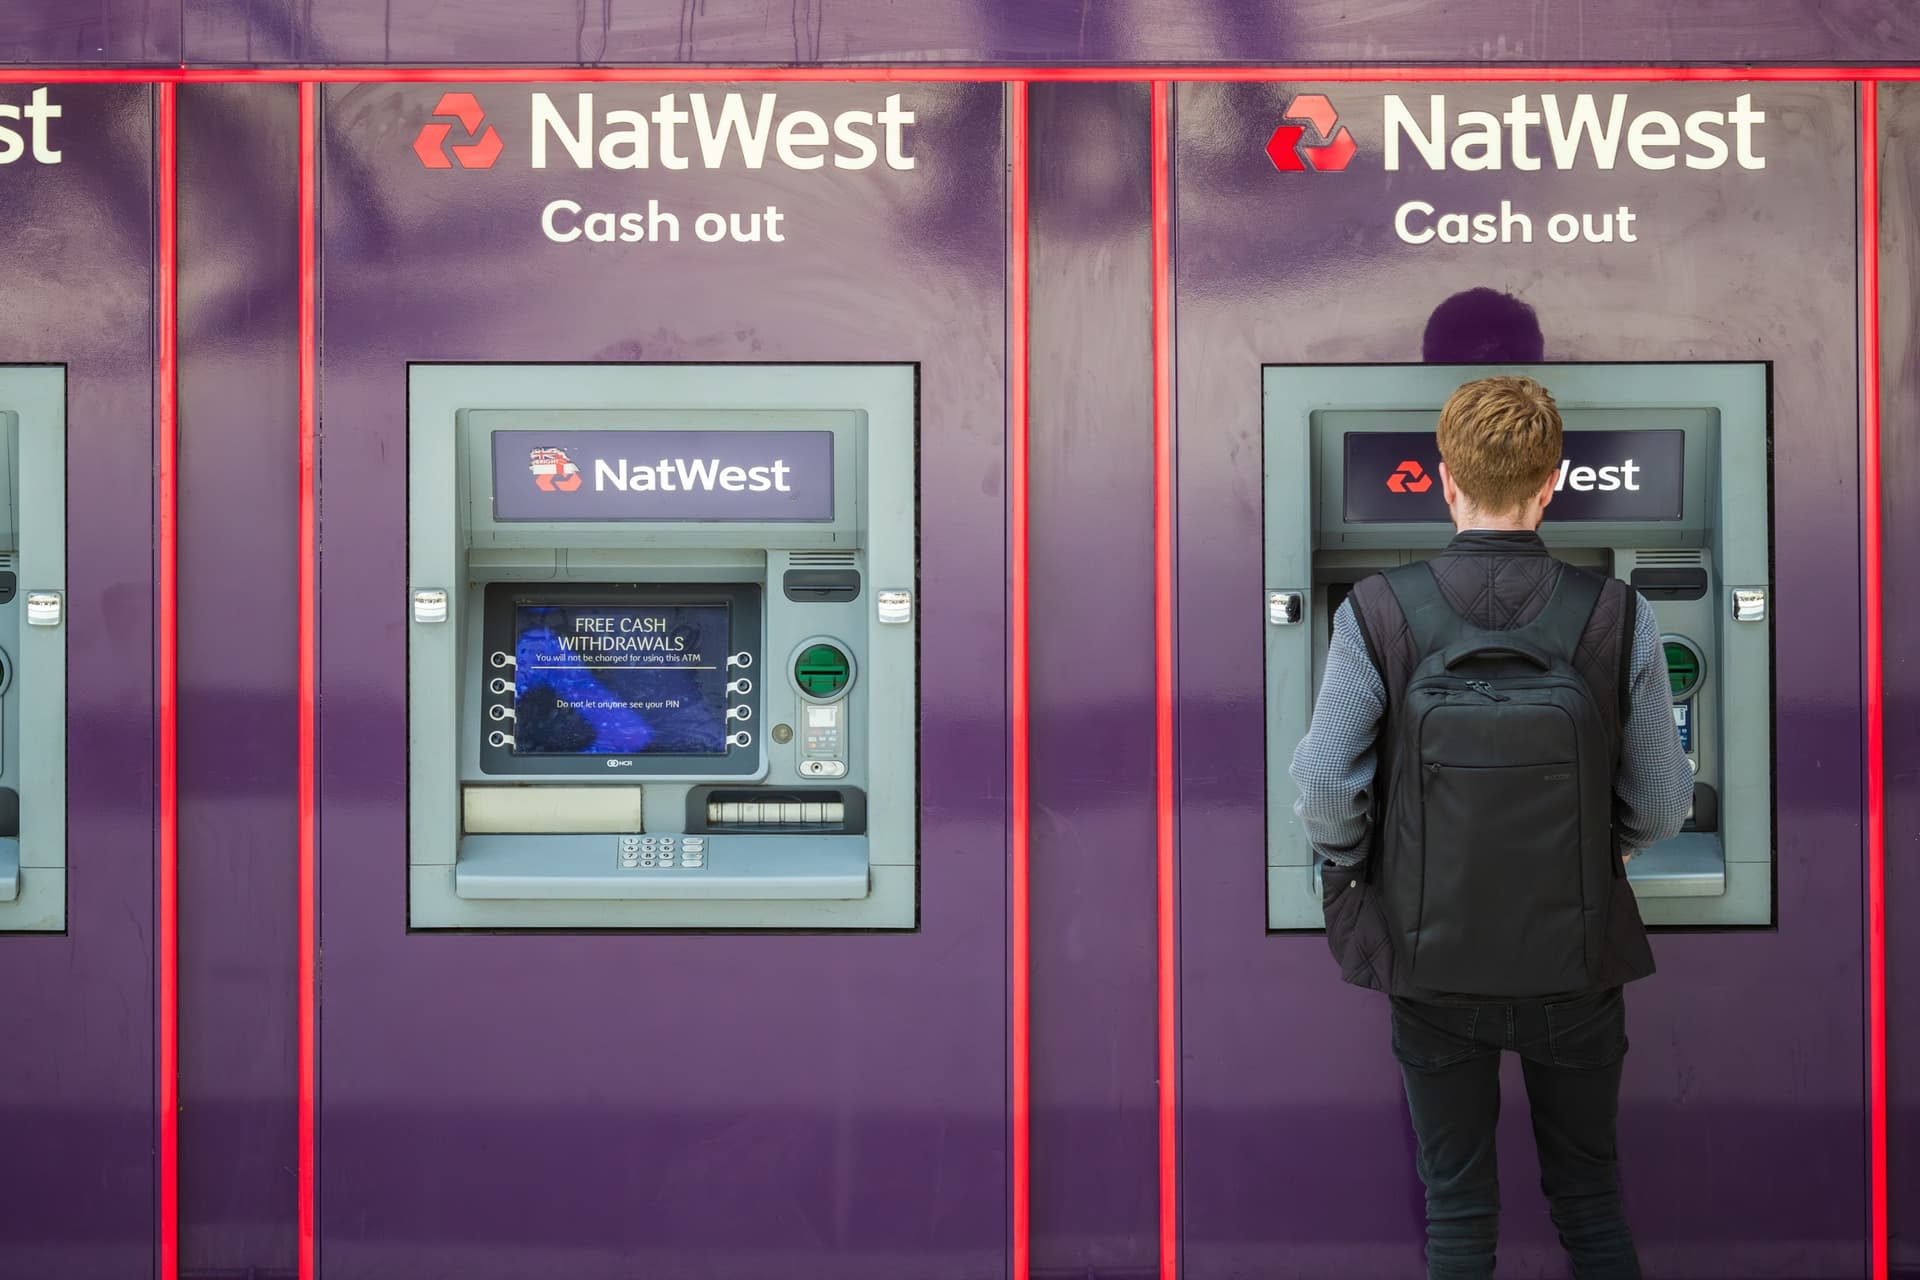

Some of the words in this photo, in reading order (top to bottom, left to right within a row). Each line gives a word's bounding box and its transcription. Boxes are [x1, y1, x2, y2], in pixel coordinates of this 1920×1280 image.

[530, 92, 916, 170] NatWest
[1383, 93, 1767, 171] NatWest
[541, 199, 681, 243] Cash
[694, 205, 786, 243] out
[1394, 200, 1533, 245] Cash
[1547, 205, 1638, 244] out
[594, 457, 791, 492] NatWest
[1555, 458, 1641, 491] est
[575, 617, 615, 633] FREE
[620, 617, 666, 633] CASH
[535, 653, 551, 662] You
[553, 653, 566, 662] will
[567, 654, 581, 662] not
[583, 653, 593, 662] be
[595, 653, 627, 664] charged
[629, 653, 641, 662] for
[643, 653, 663, 664] using
[665, 653, 680, 662] this
[682, 653, 701, 662] ATM
[558, 636, 685, 651] WITHDRAWALS
[556, 700, 569, 708] Do
[585, 700, 596, 708] let
[597, 701, 627, 710] anyone
[645, 702, 663, 710] your
[665, 700, 680, 708] PIN
